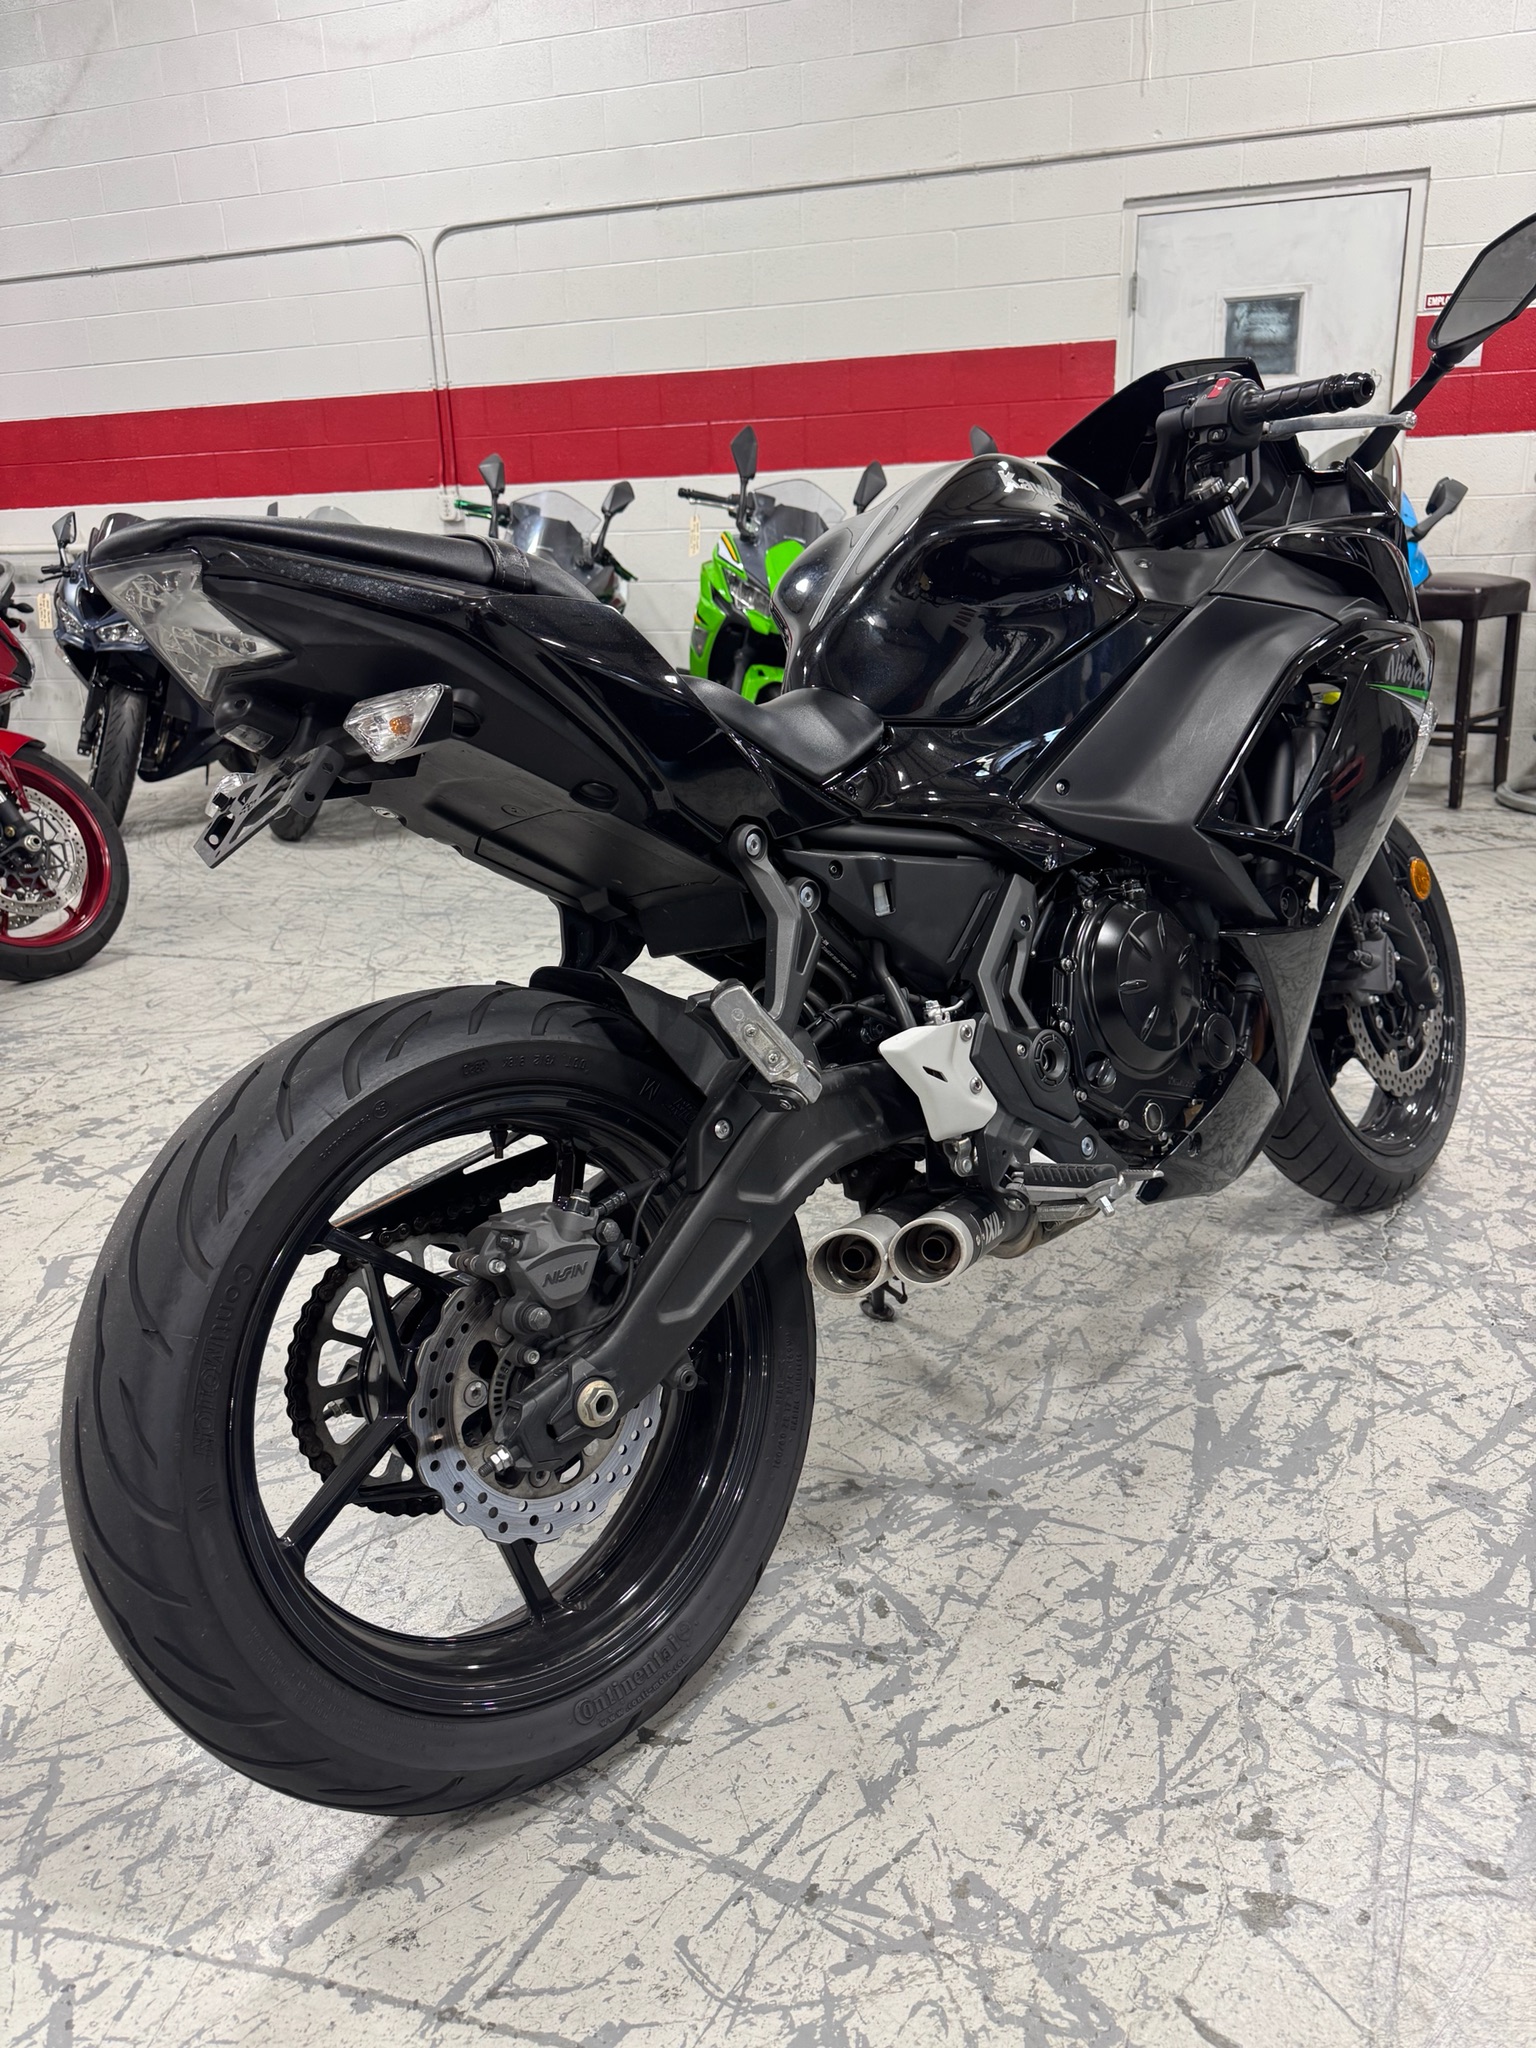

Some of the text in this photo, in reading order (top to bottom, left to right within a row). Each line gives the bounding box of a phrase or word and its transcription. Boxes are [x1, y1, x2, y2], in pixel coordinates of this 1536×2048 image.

[1385, 653, 1425, 689] Ninja
[982, 1211, 1003, 1245] IXIL
[542, 1260, 588, 1288] NISSIN
[574, 1633, 680, 1725] Continental
